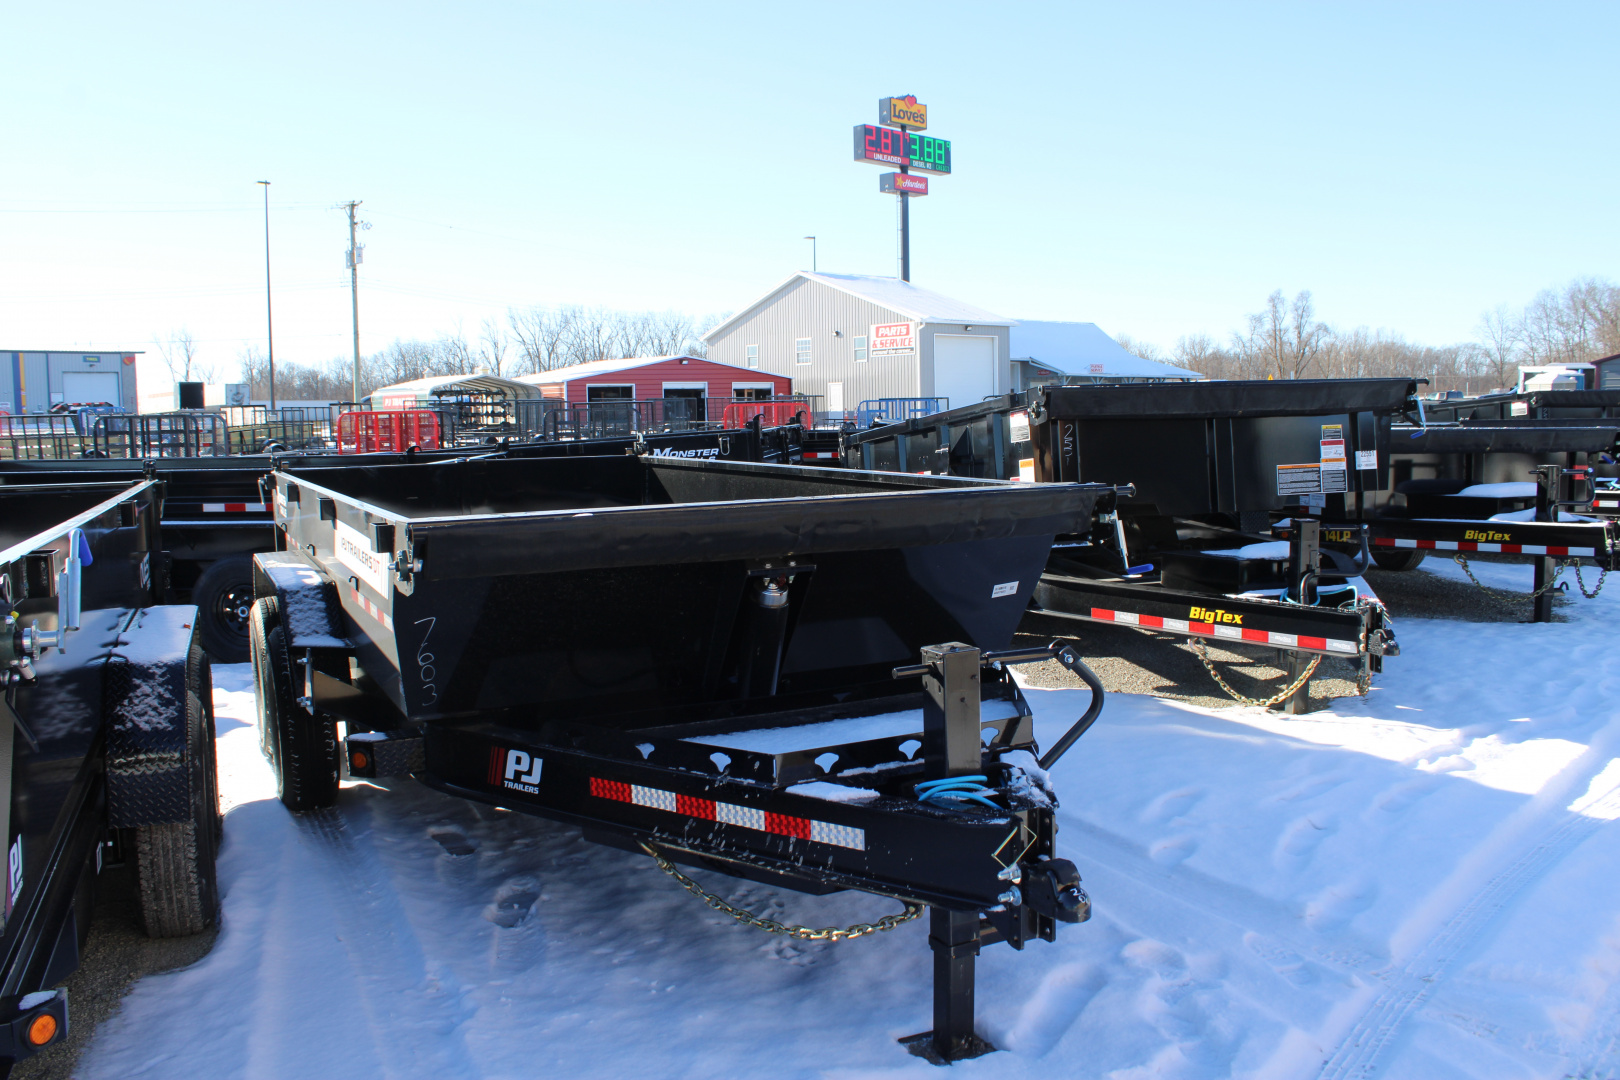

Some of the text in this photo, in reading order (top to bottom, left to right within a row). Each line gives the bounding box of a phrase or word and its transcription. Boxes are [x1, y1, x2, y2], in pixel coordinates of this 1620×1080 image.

[892, 103, 926, 123] Love's
[873, 153, 902, 163] UNLEADED
[878, 325, 908, 337] PARTS
[872, 337, 914, 349] & SERVICE
[1324, 530, 1352, 543] 14LP
[1464, 530, 1511, 542] BigTex
[1189, 606, 1244, 625] BigTex
[414, 616, 438, 706] 7603
[504, 748, 544, 785] PJ
[503, 780, 540, 795] TRAILERS
[9, 833, 23, 894] PJ
